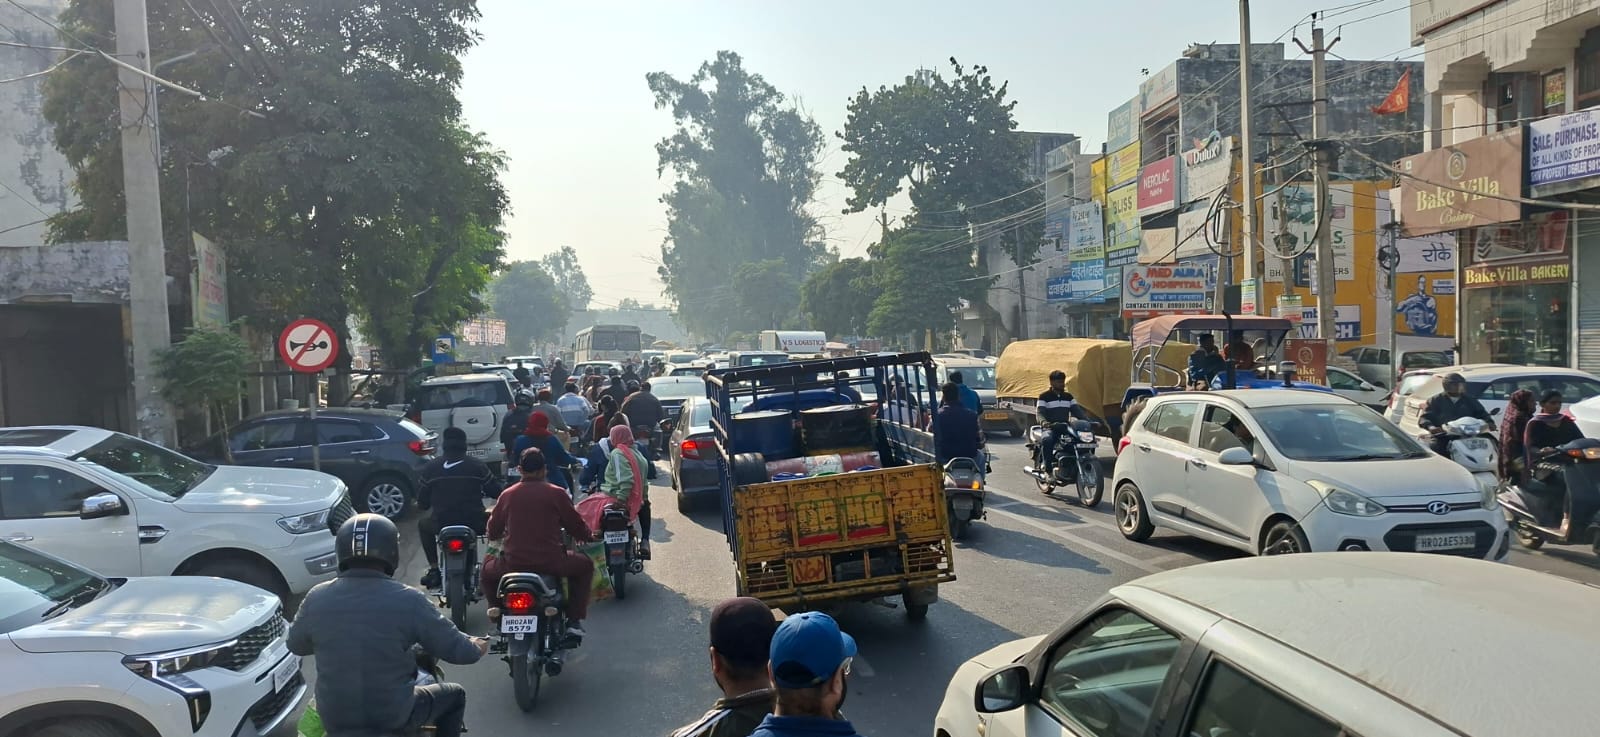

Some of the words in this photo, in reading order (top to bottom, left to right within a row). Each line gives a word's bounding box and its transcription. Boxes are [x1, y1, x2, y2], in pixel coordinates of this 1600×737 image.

[1193, 145, 1218, 165] Dulux
[1532, 156, 1540, 167] OF
[1541, 153, 1552, 165] ALL
[1554, 150, 1573, 163] KINDS
[1573, 146, 1582, 158] OF
[1143, 169, 1170, 190] NEROLAC
[1415, 186, 1455, 212] Bake
[1458, 176, 1500, 204] Villa
[1146, 268, 1172, 278] MED
[1172, 268, 1204, 278] AURA
[1465, 266, 1496, 284] Bake
[1496, 266, 1527, 282] Villa
[1530, 263, 1569, 280] BAKERY
[1151, 280, 1203, 289] HOSPITAL
[1297, 365, 1315, 375] ake
[505, 618, 534, 626] HR02AW
